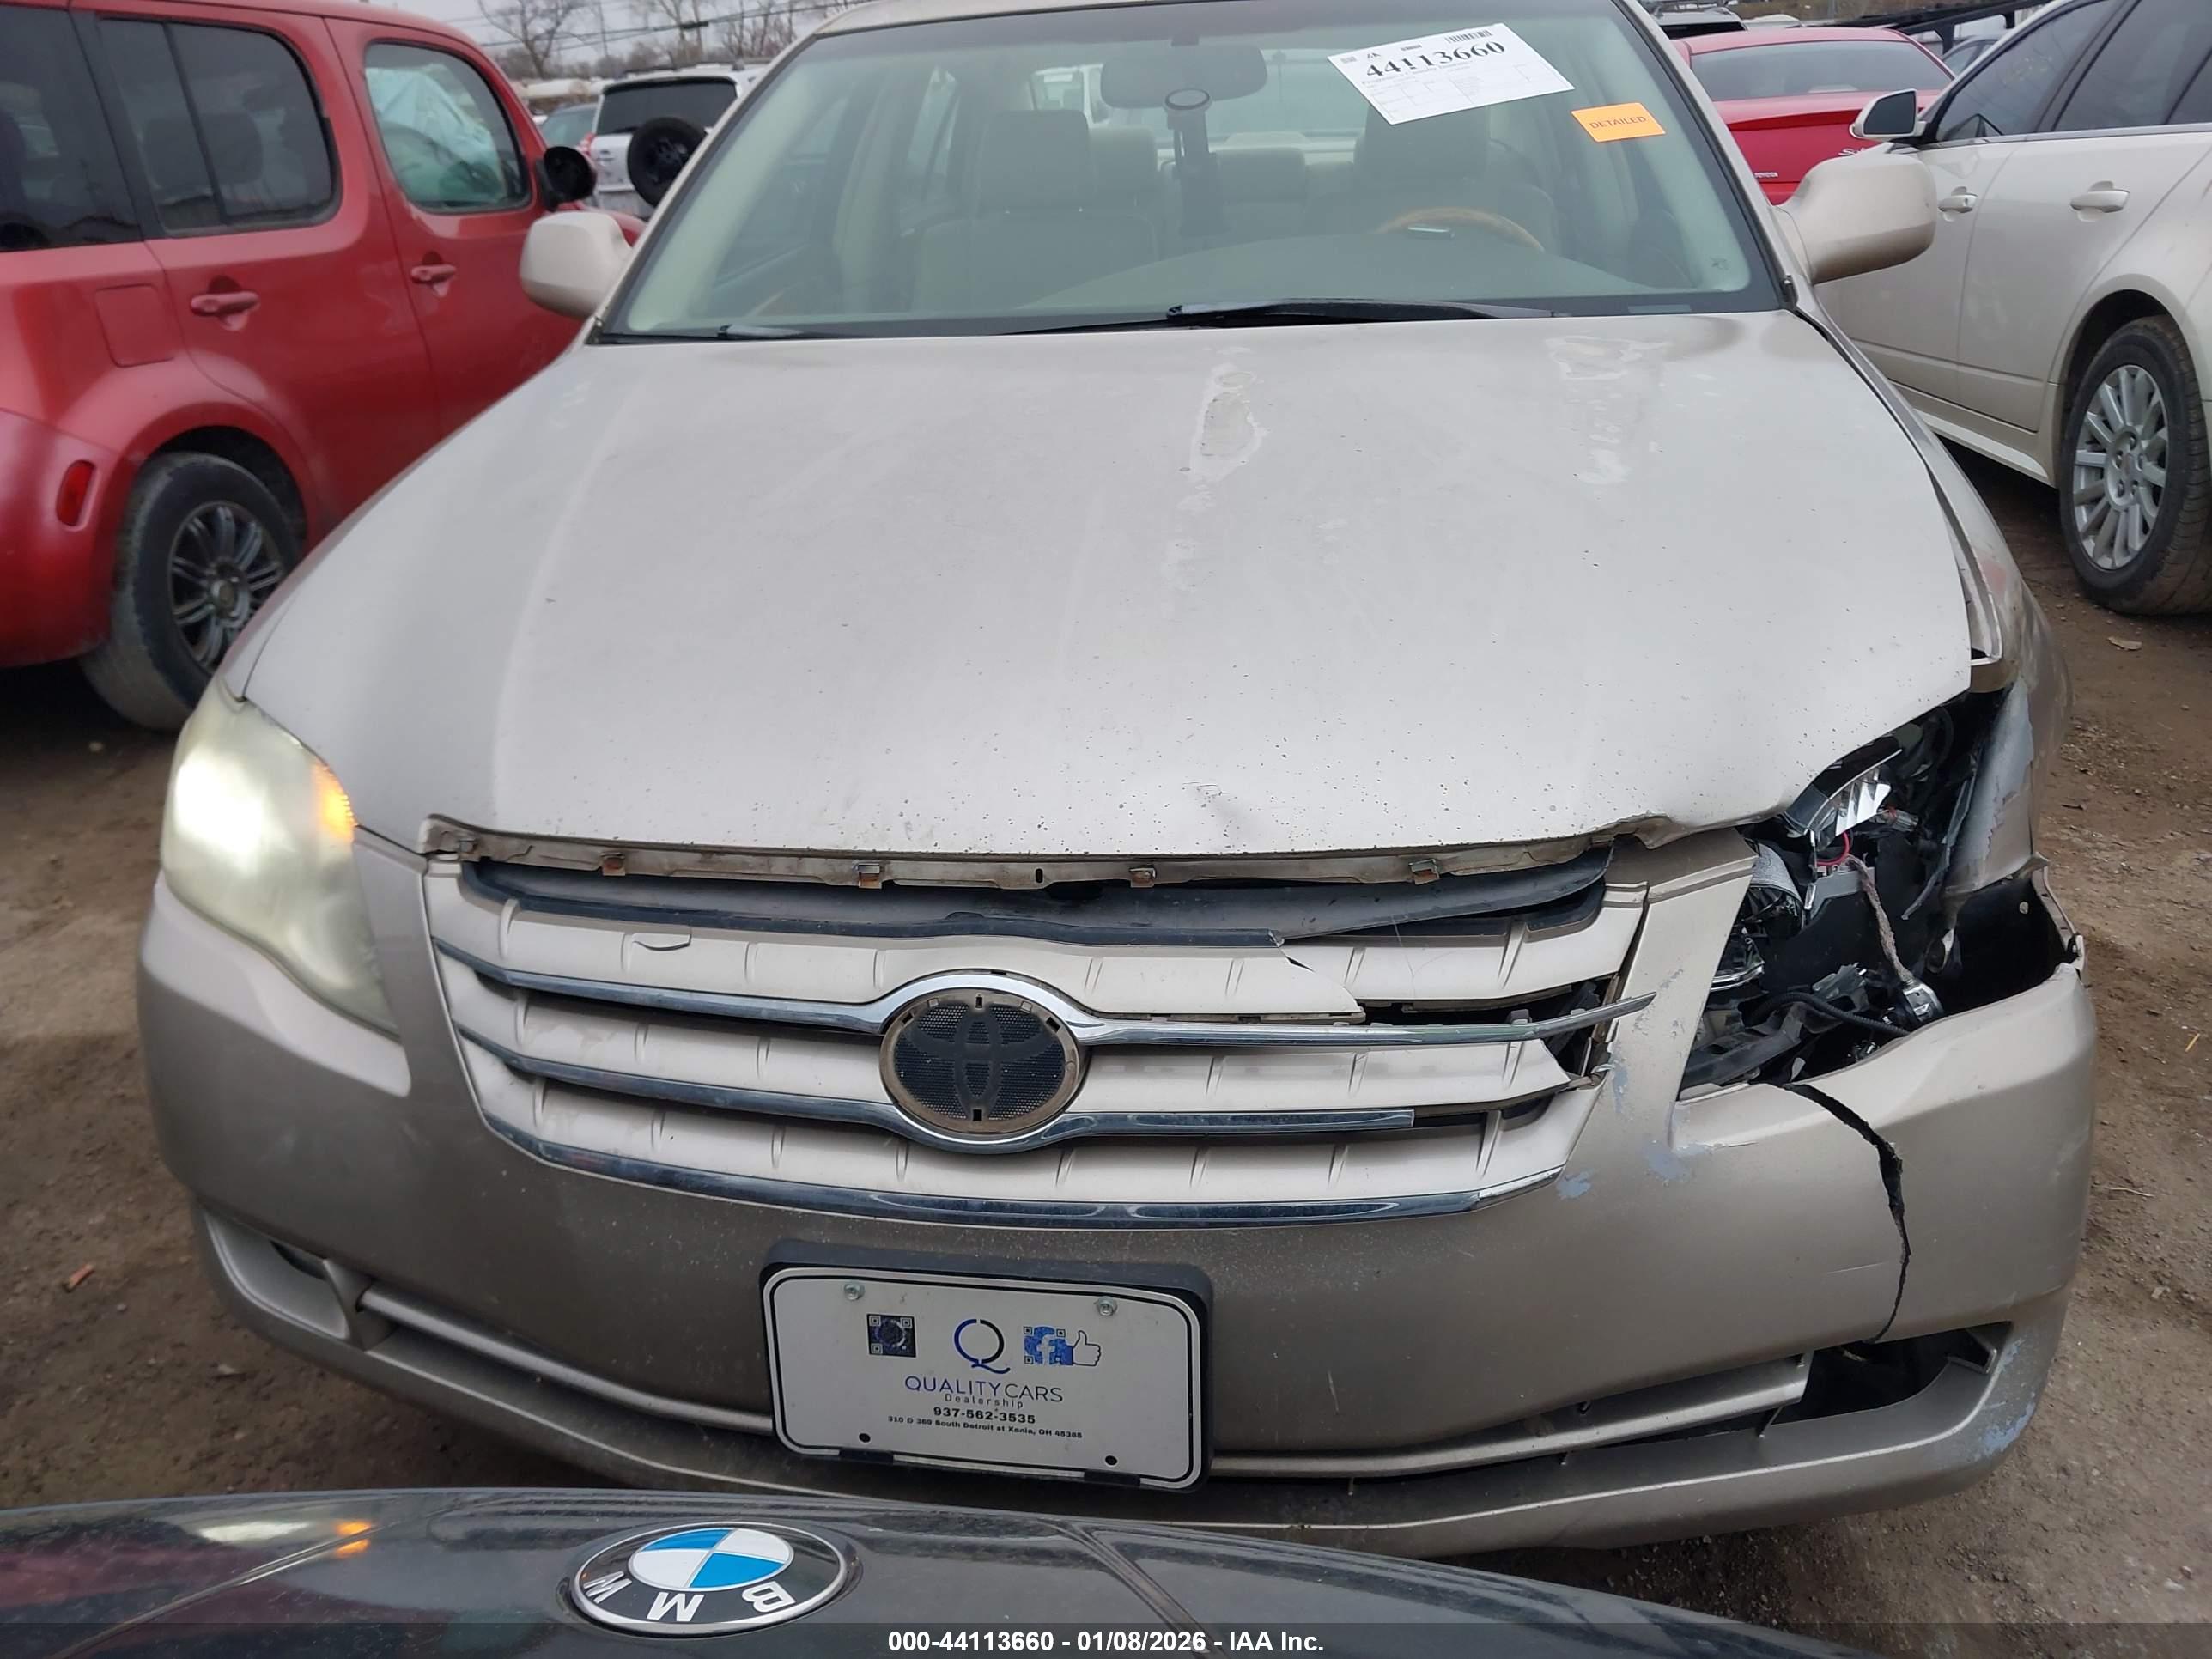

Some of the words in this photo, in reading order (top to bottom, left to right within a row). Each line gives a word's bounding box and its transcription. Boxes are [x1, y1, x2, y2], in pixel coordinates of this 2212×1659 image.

[1366, 40, 1506, 76] 44113660
[1589, 116, 1647, 129] DETAILED
[945, 1393, 1024, 1409] Dealership
[933, 1407, 1036, 1425] 937-562-3535
[935, 1419, 960, 1428] South
[963, 1422, 994, 1431] Detroit
[583, 1571, 796, 1622] BMW
